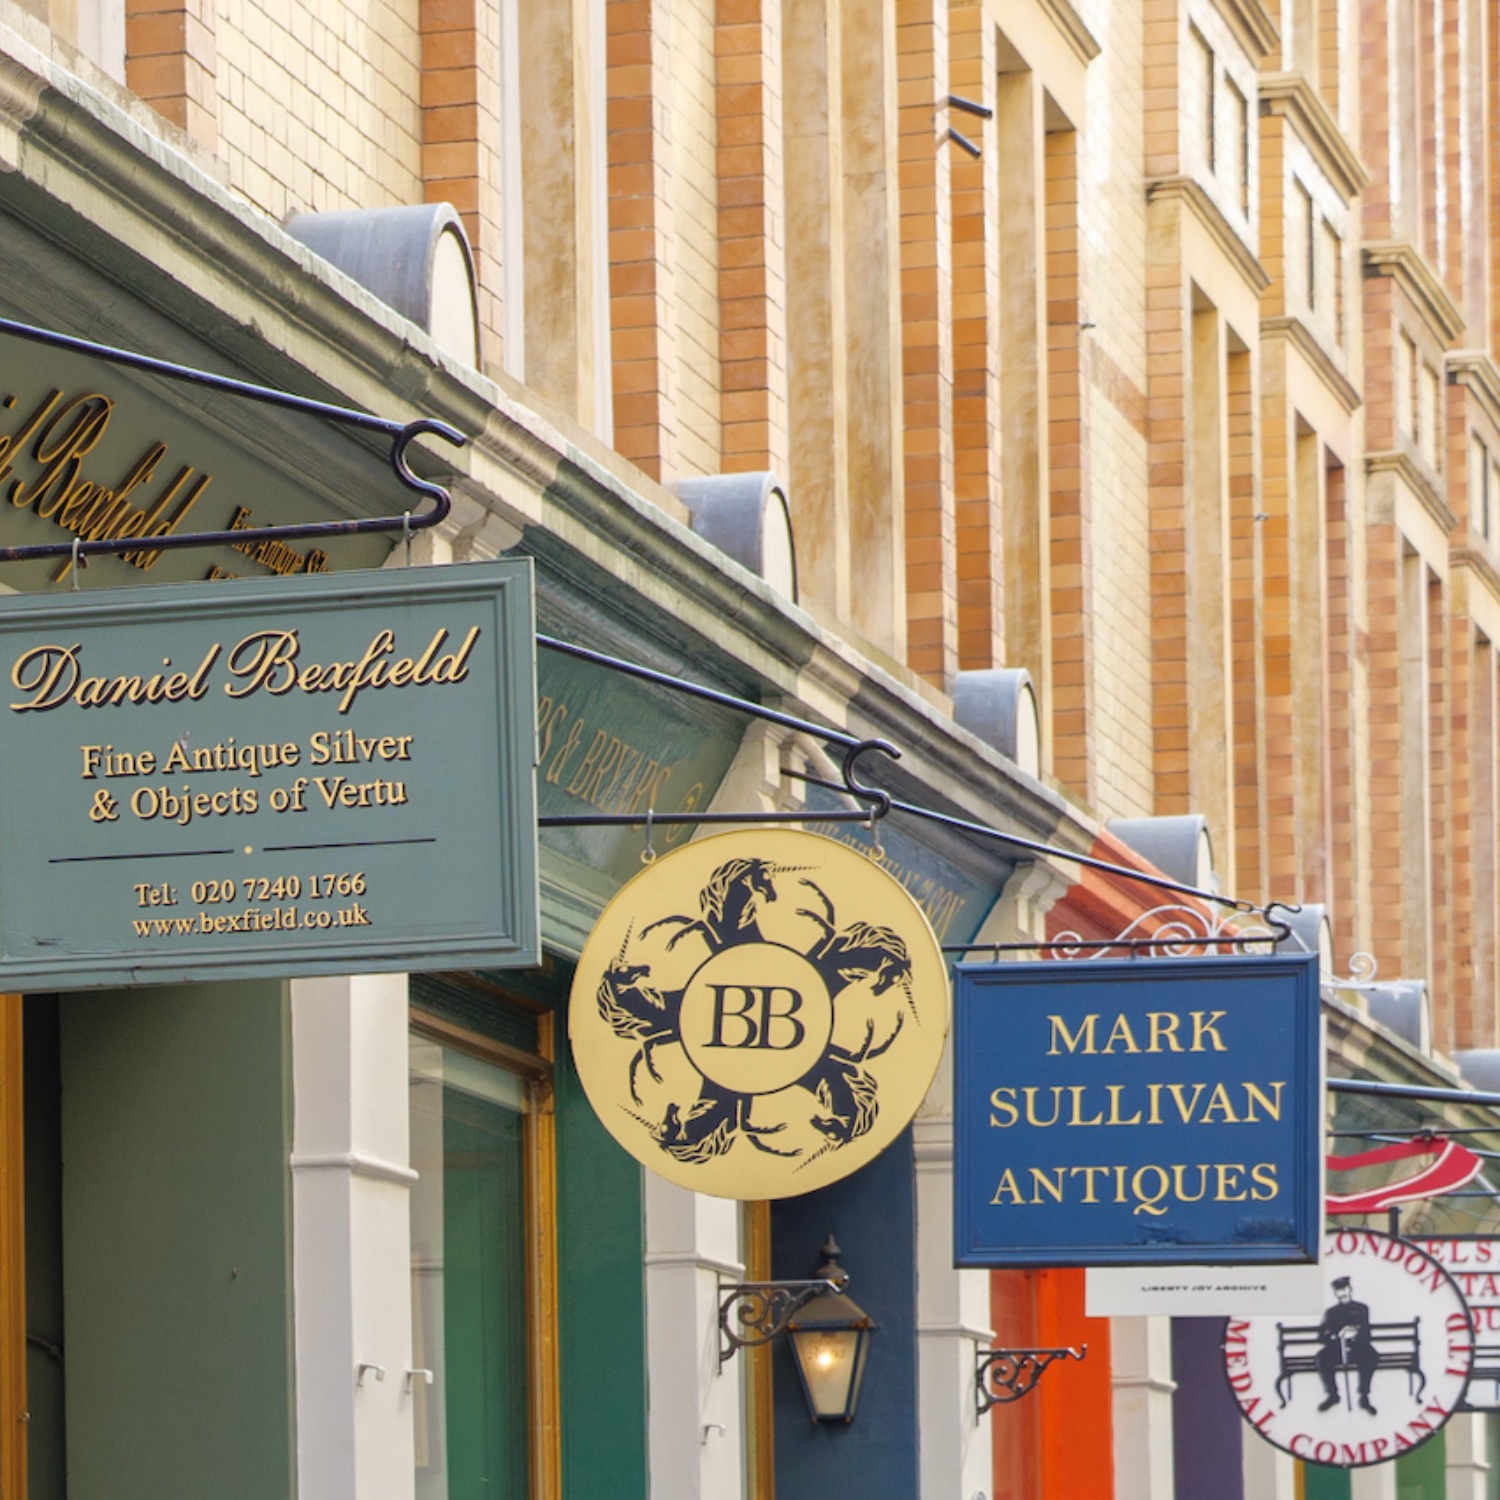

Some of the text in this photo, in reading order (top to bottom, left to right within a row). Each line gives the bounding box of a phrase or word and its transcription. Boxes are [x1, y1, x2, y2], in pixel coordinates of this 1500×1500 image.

[6, 622, 484, 715] Daniel Bexfield
[78, 726, 415, 781] Fine Antique Silver
[86, 772, 409, 827] & Objects of Vertu
[131, 868, 368, 909] Tel: 020 7240 1766
[130, 900, 373, 940] www.bexfield.co.uk
[701, 984, 806, 1050] BB
[1048, 1011, 1226, 1054] MARK
[991, 1082, 1285, 1126] SULLIVAN
[991, 1164, 1278, 1215] ANTIQUES
[1141, 1284, 1188, 1292] LIBERTY
[1325, 1231, 1450, 1294] ONDON
[1445, 1312, 1473, 1378] LTD
[1225, 1317, 1277, 1437] MEDAL
[1288, 1395, 1451, 1463] COMPANY
